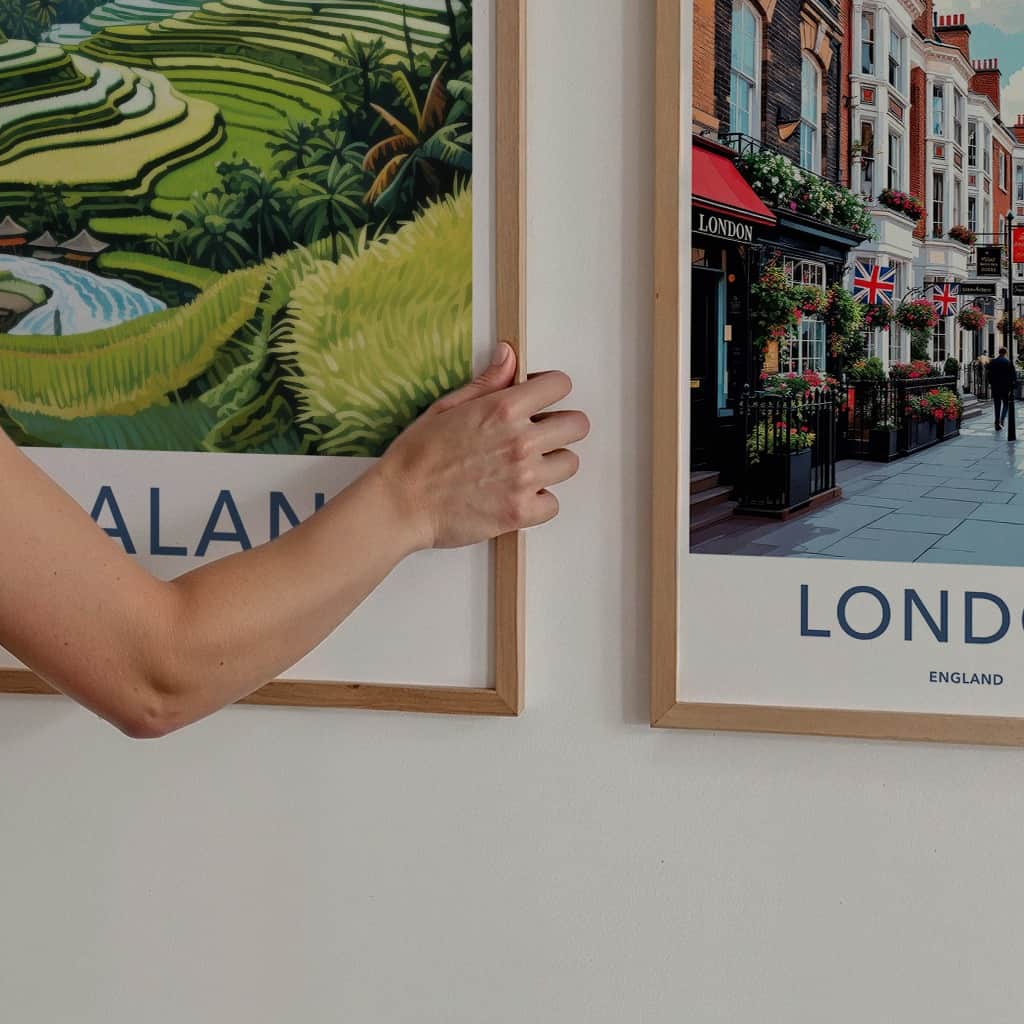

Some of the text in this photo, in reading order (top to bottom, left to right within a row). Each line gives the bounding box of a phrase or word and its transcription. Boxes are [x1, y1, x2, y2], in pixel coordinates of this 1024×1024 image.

[698, 213, 753, 242] LONDON
[800, 583, 1024, 645] LOND
[929, 670, 1004, 686] ENGLAND
